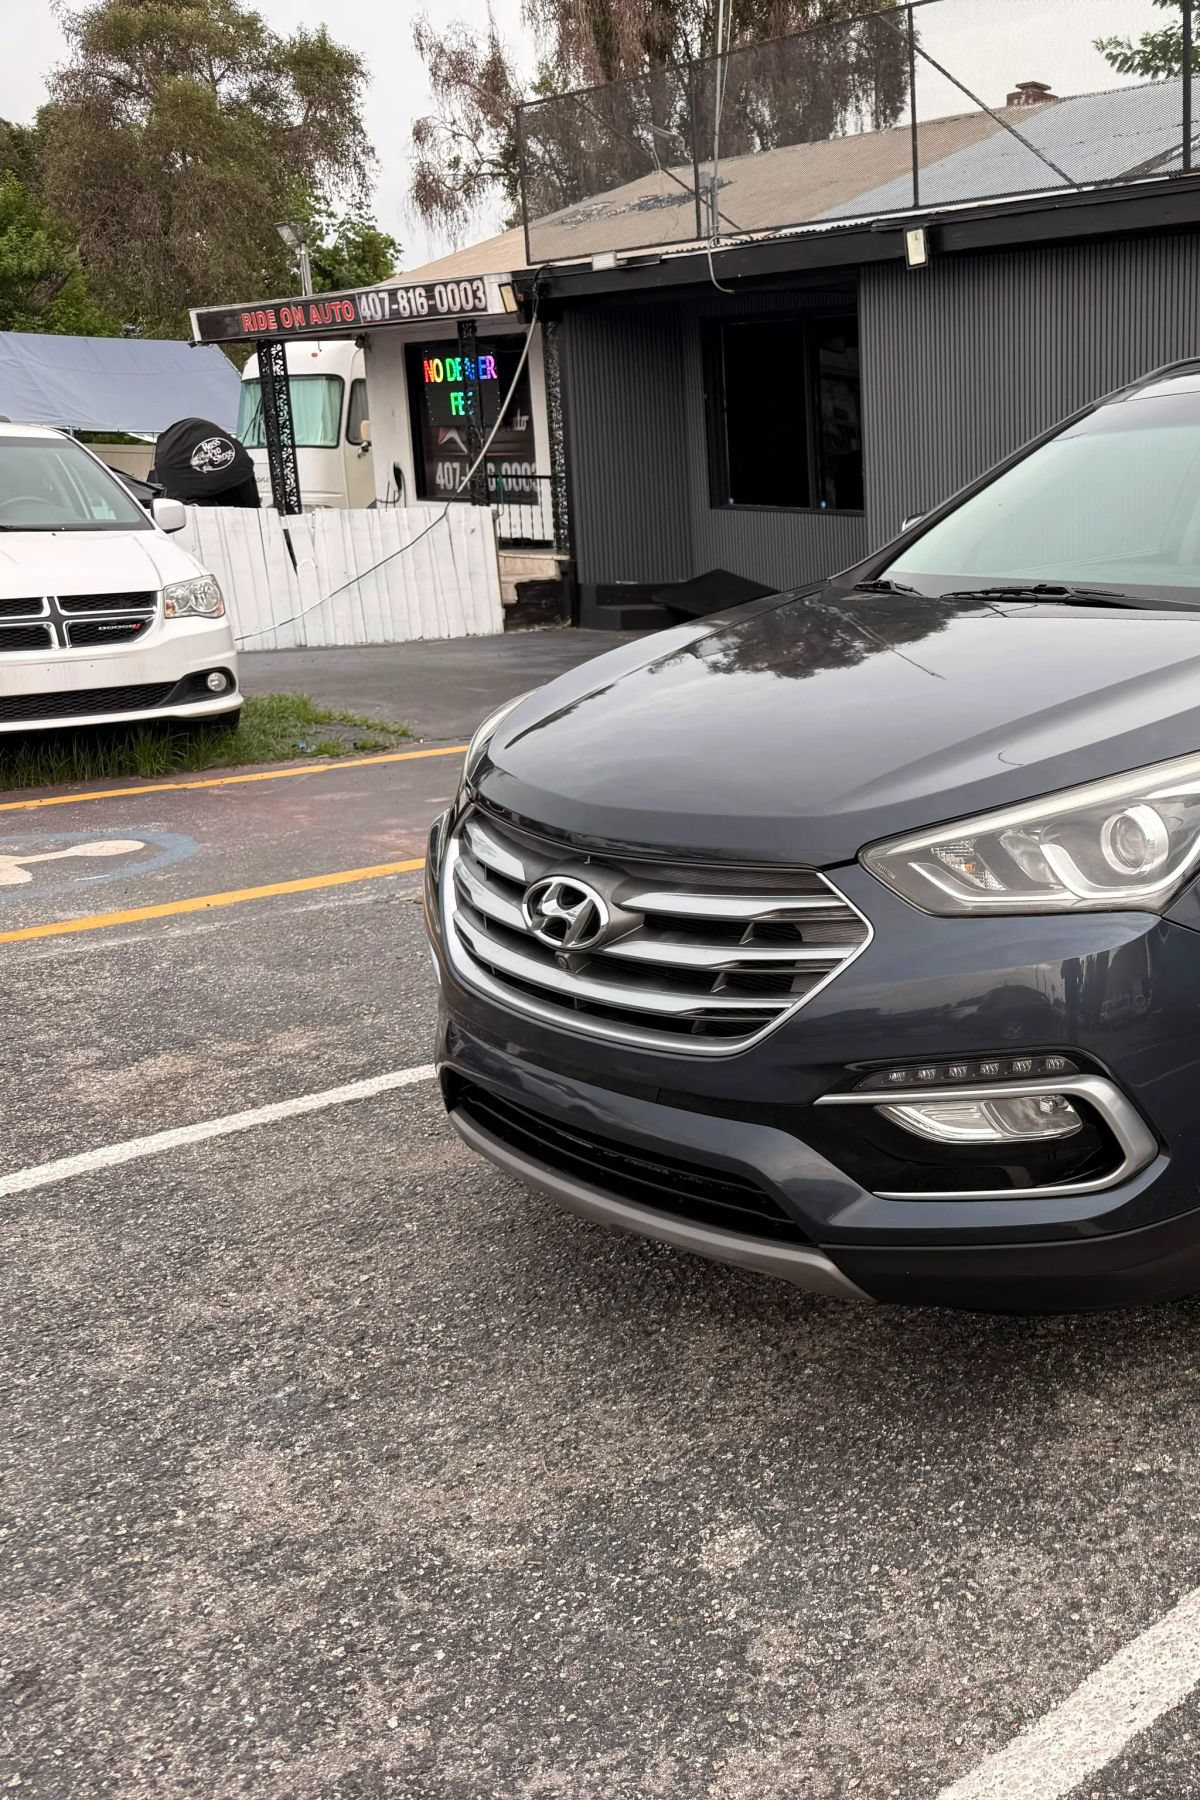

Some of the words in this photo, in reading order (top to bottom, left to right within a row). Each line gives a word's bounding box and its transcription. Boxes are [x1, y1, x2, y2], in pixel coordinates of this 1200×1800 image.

[241, 309, 277, 332] RIDE
[282, 306, 306, 328] ON
[309, 300, 356, 325] AUTO
[360, 279, 486, 321] 407-816-0003
[423, 358, 444, 383] NO
[201, 439, 221, 453] Bass
[208, 447, 222, 458] Pro
